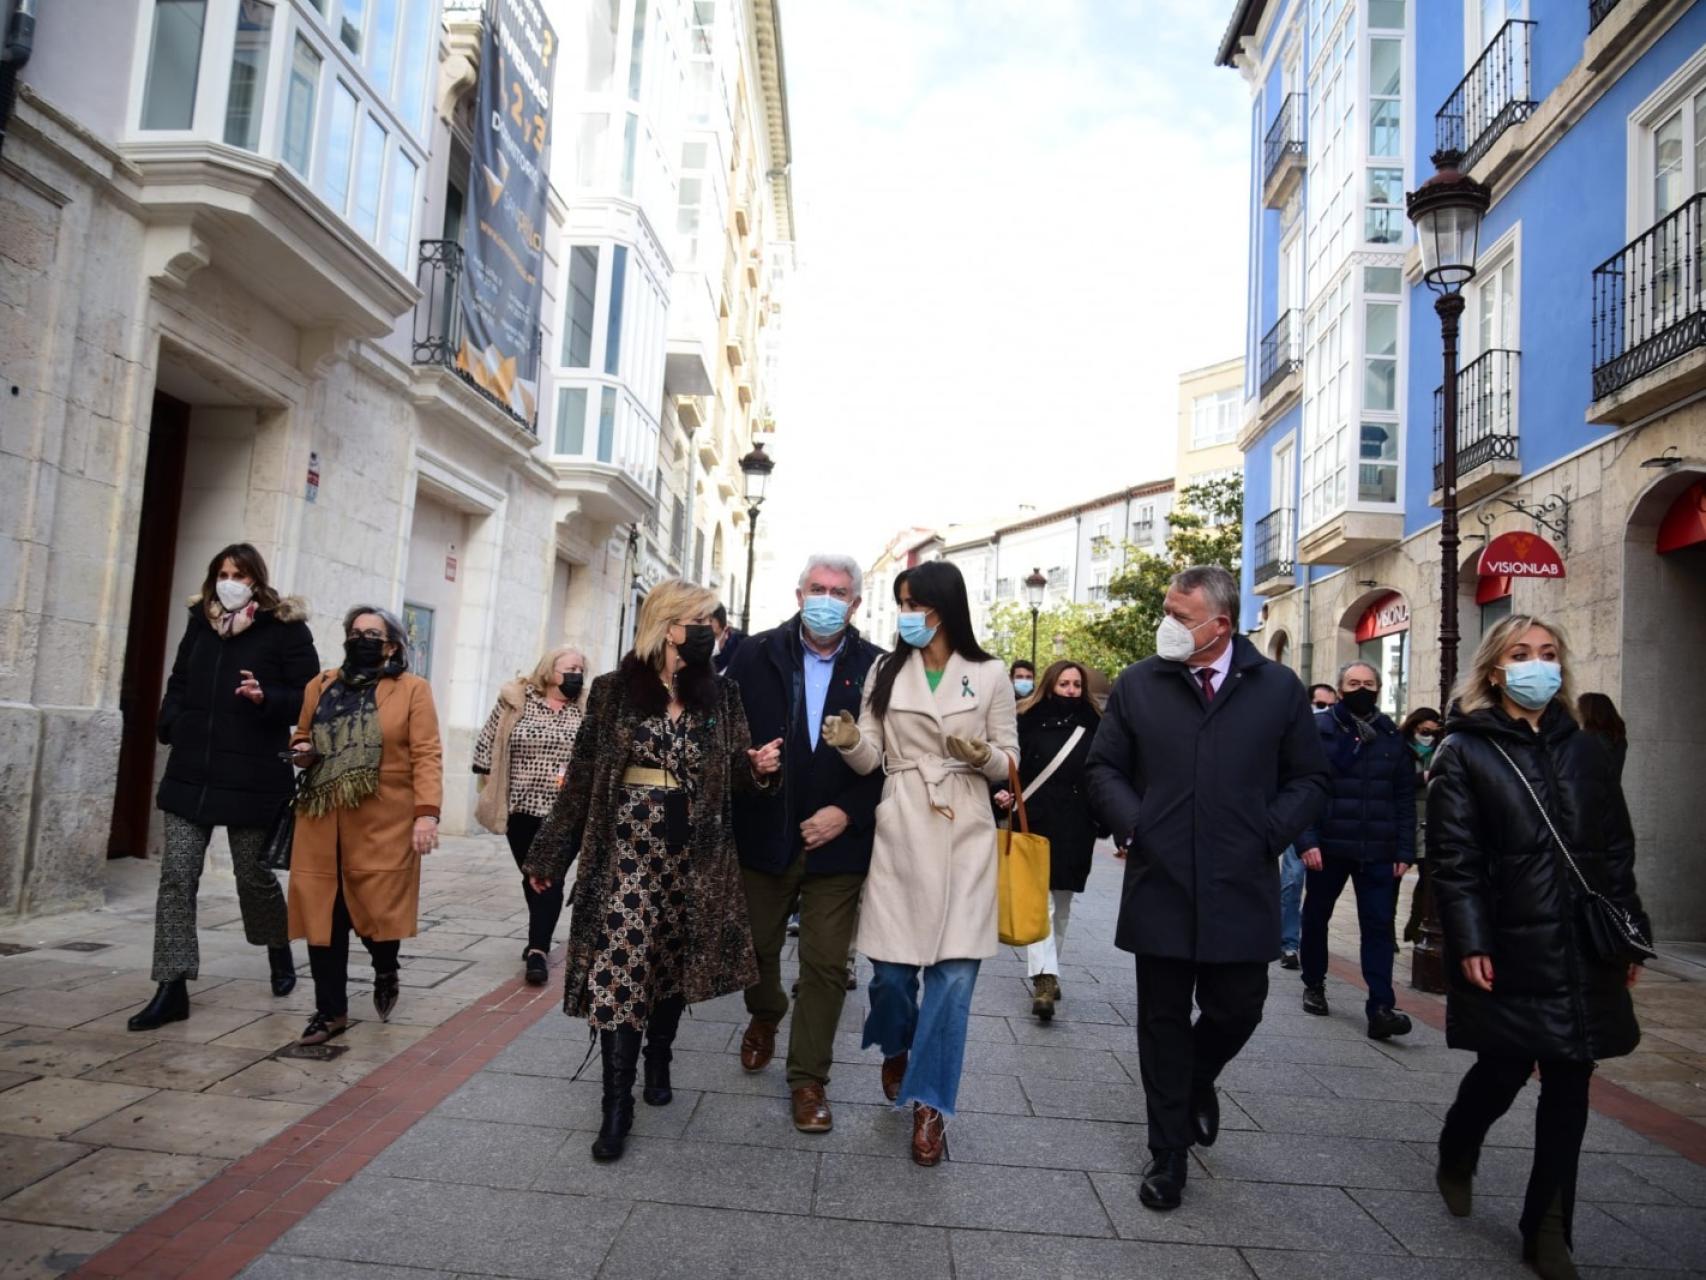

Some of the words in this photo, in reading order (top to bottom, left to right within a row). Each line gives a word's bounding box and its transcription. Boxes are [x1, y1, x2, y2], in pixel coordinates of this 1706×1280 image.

[511, 81, 523, 129] 2
[533, 113, 547, 153] 3
[1487, 561, 1559, 575] VISIONLAB
